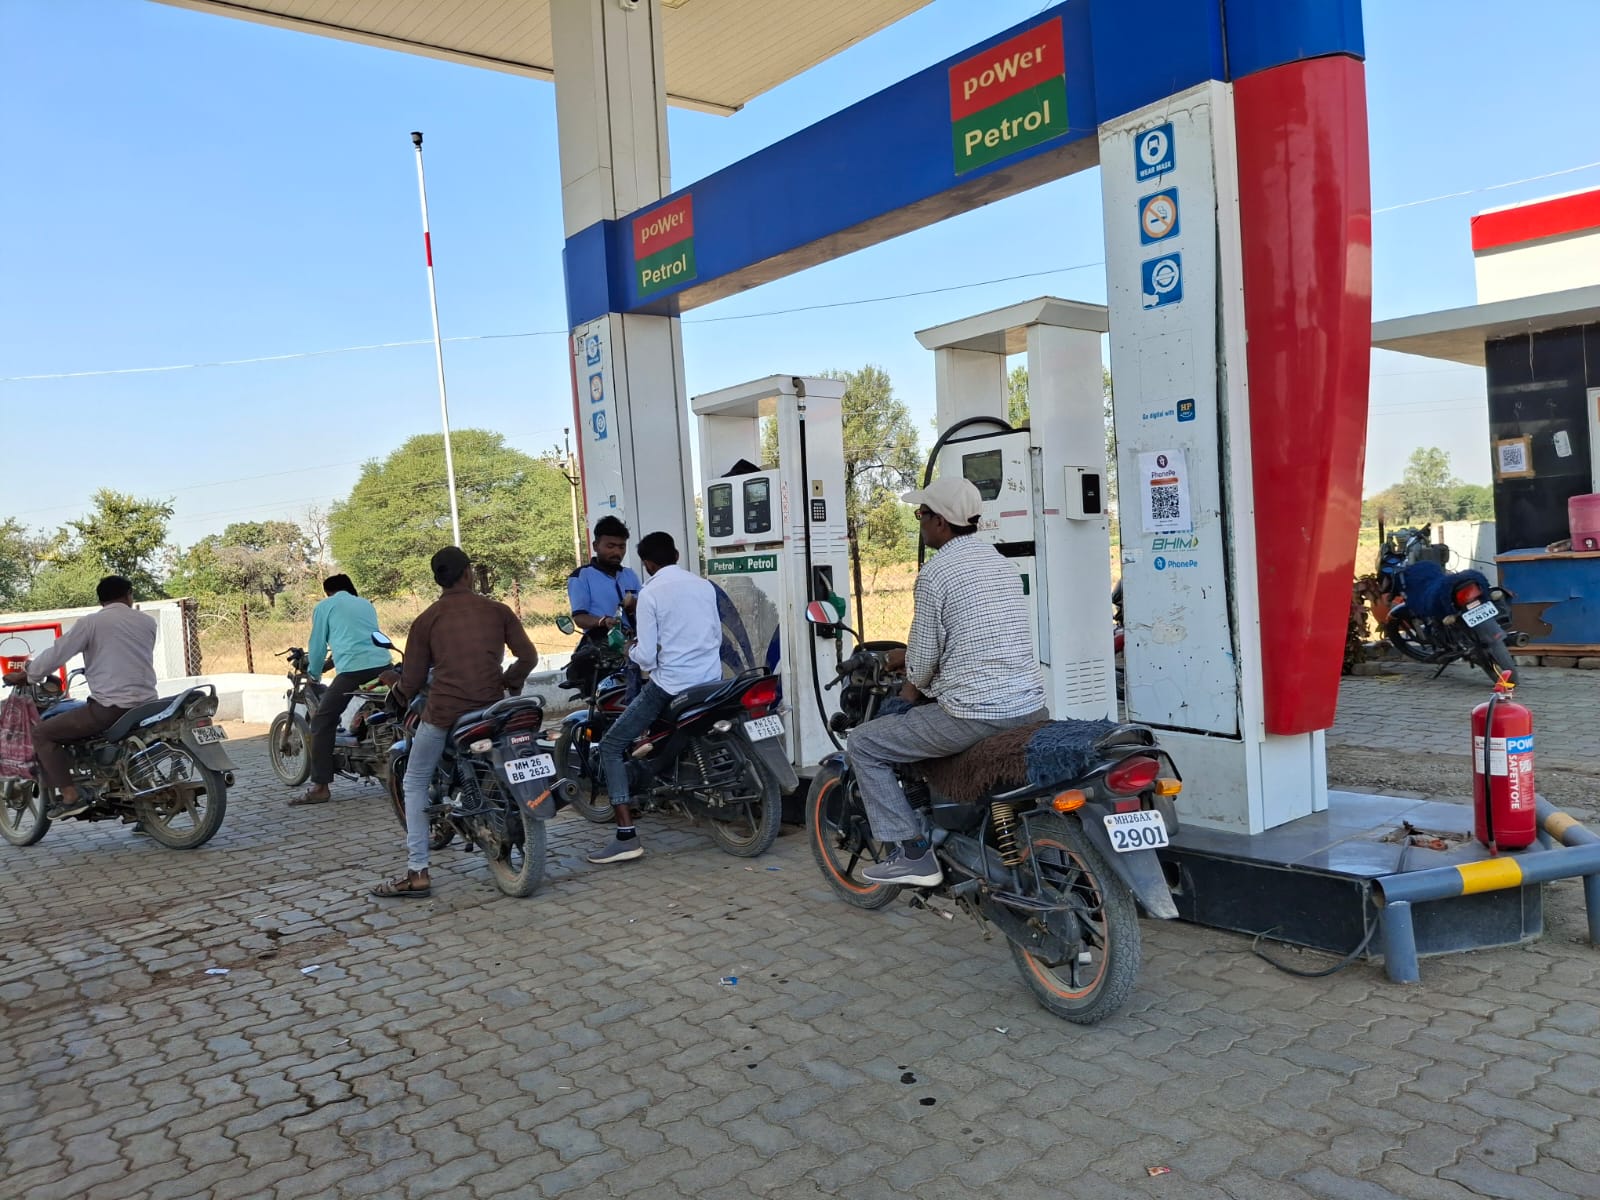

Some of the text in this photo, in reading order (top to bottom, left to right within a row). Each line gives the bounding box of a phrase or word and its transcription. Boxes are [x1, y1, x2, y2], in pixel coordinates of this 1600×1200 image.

[964, 99, 1051, 156] Petrol
[641, 253, 687, 288] Petrol
[1151, 470, 1176, 478] PhonePe
[1151, 537, 1192, 551] BHIM
[713, 557, 774, 571] Petrol Petrol
[1167, 560, 1198, 568] PhonePe
[514, 758, 542, 771] MH 26
[512, 765, 551, 781] BB 2623
[1113, 811, 1152, 825] MH26AX
[1113, 825, 1167, 849] 2901
